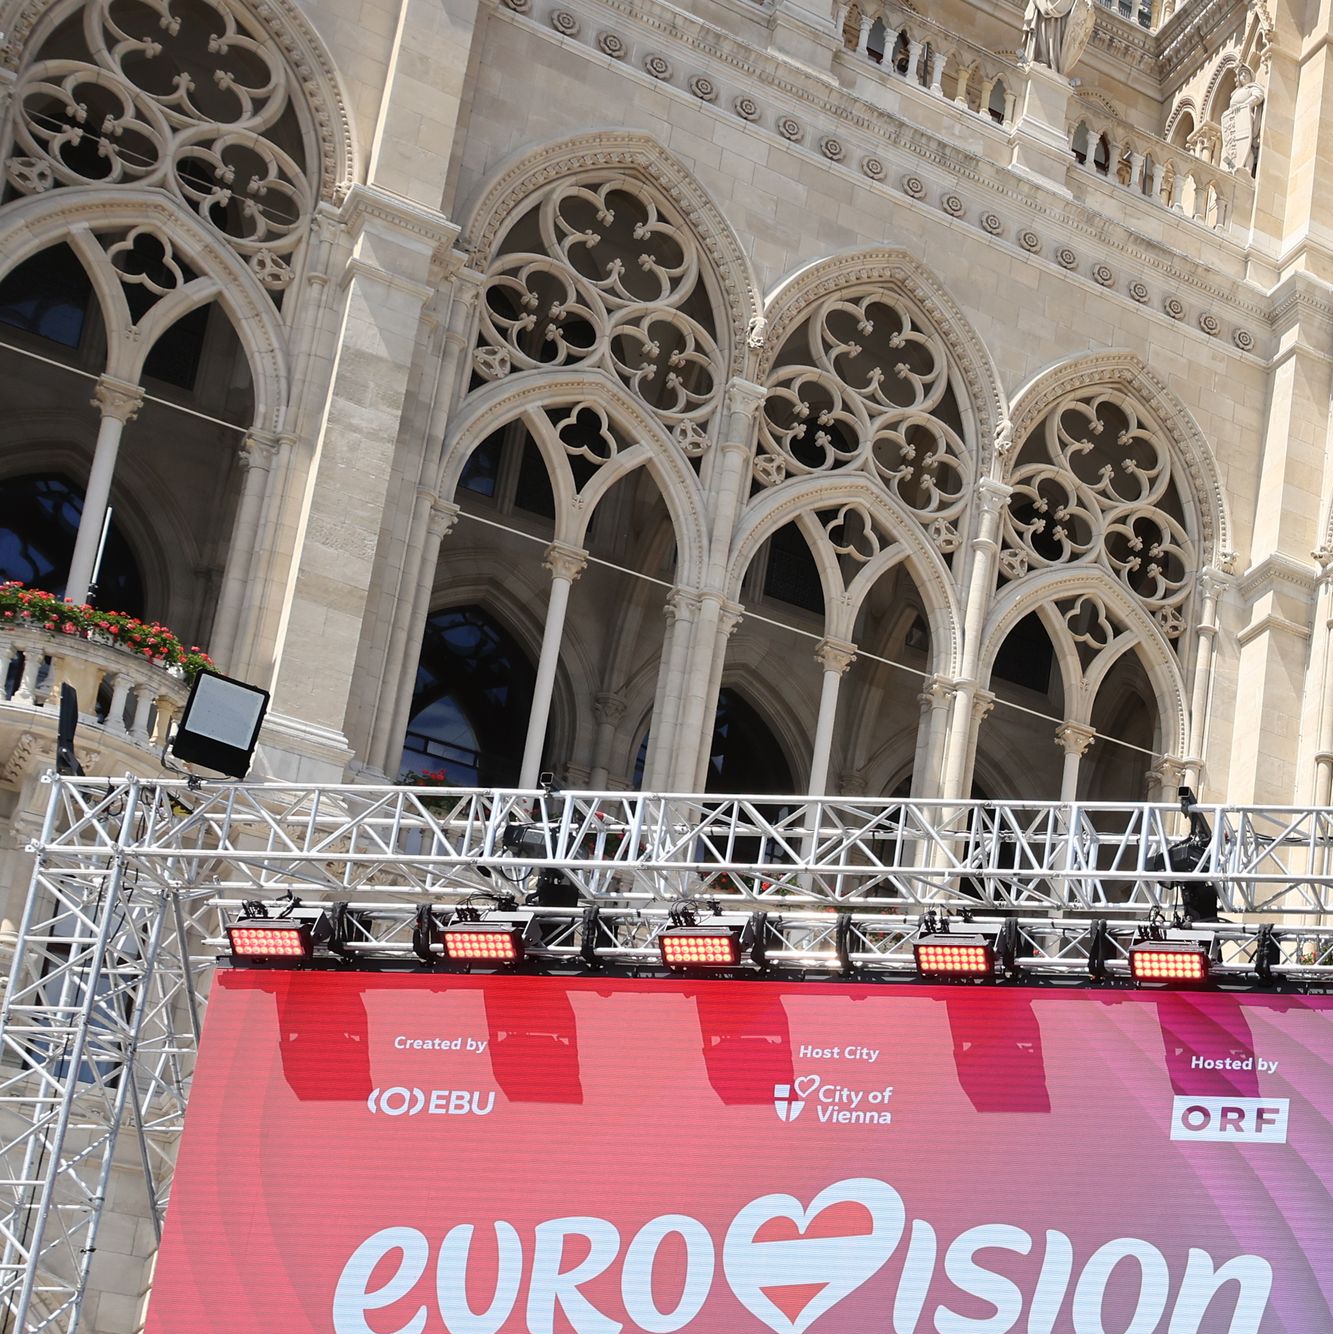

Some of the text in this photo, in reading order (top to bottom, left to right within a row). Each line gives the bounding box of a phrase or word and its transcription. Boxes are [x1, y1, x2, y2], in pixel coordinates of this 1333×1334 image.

[394, 1036, 487, 1053] Created by
[799, 1045, 880, 1062] Host City
[1191, 1056, 1278, 1073] Hosted by
[818, 1085, 893, 1108] City of
[817, 1105, 892, 1124] Vienna
[1181, 1105, 1280, 1133] ORF
